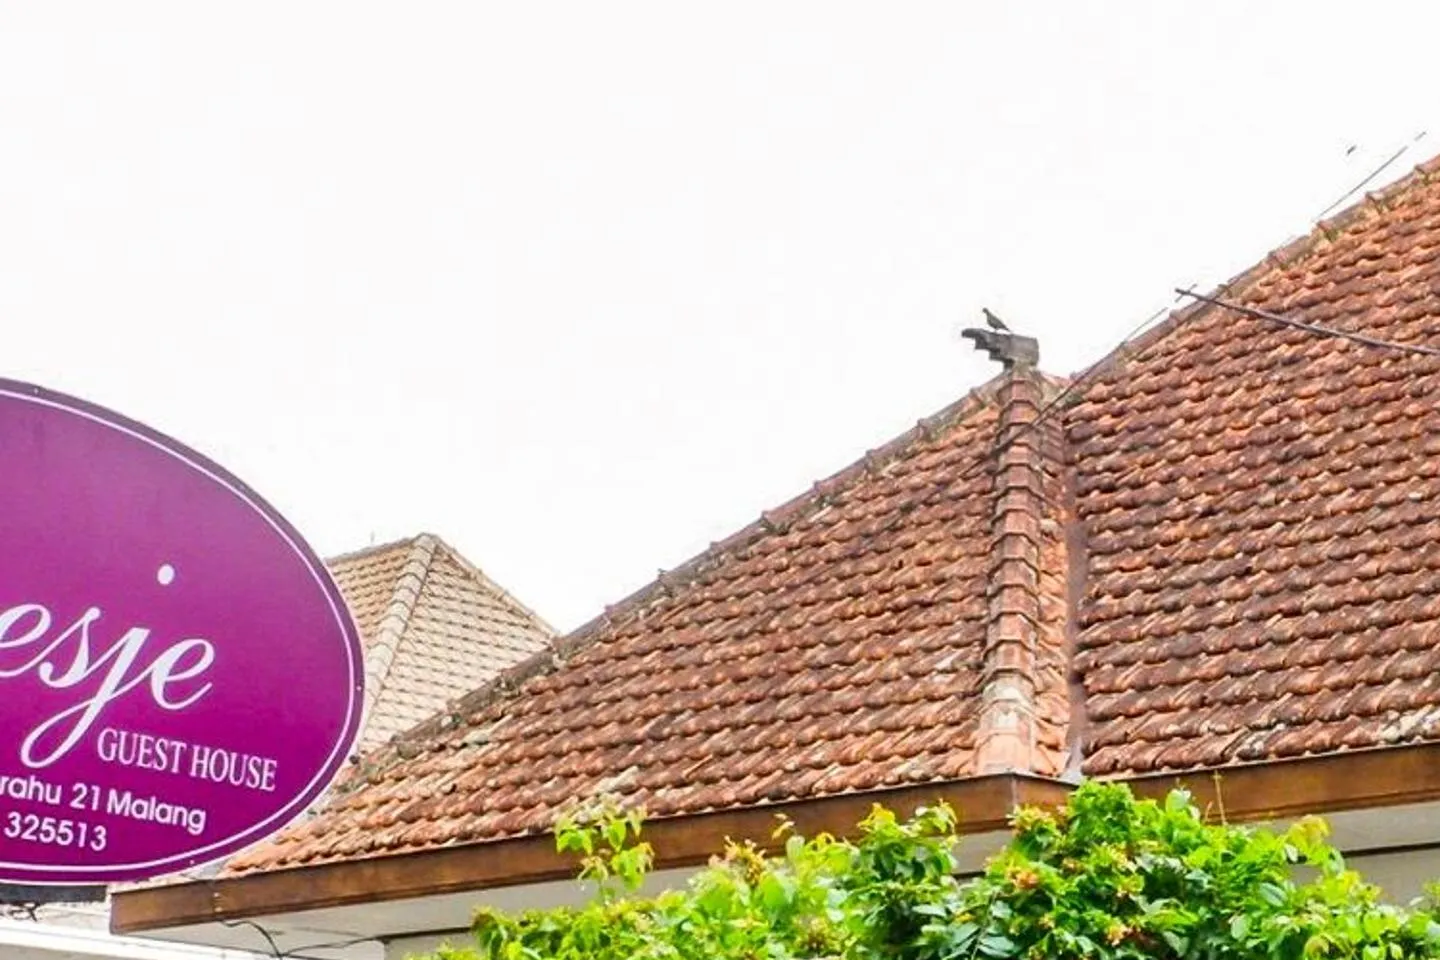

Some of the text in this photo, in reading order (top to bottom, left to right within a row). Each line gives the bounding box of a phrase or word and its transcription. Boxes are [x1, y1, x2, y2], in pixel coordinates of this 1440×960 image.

[97, 727, 278, 792] GUEST HOUSE
[3, 811, 107, 851] 325513
[69, 782, 102, 812] 21
[106, 788, 207, 836] Malang
